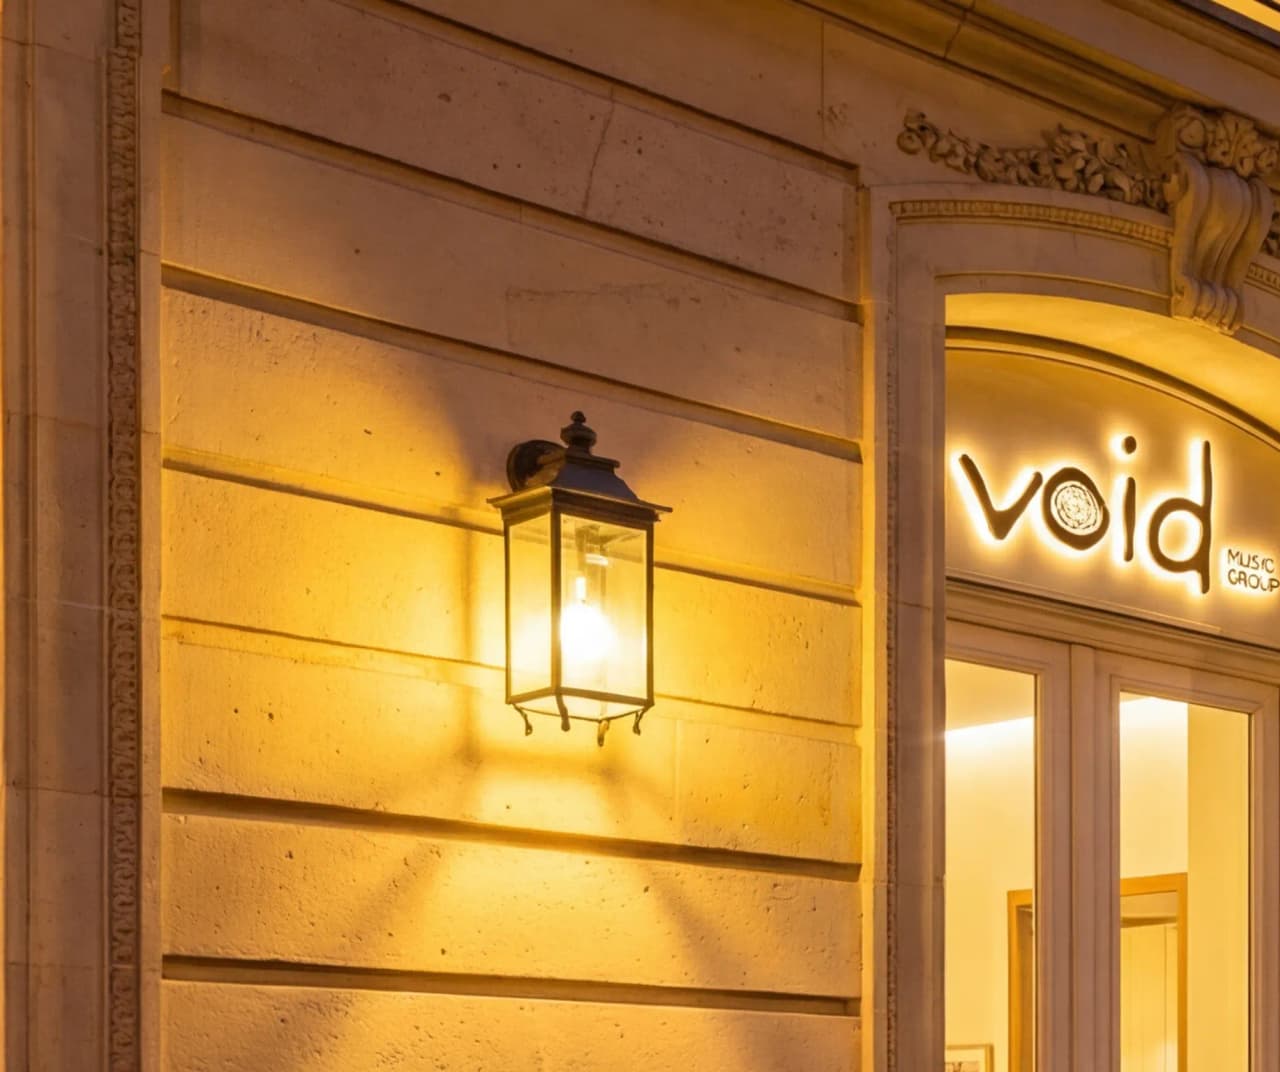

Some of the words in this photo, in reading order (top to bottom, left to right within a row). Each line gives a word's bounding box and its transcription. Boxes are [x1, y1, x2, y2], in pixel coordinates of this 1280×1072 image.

[959, 435, 1212, 594] void
[1227, 548, 1275, 574] MUSIC
[1227, 568, 1280, 592] GROUP
